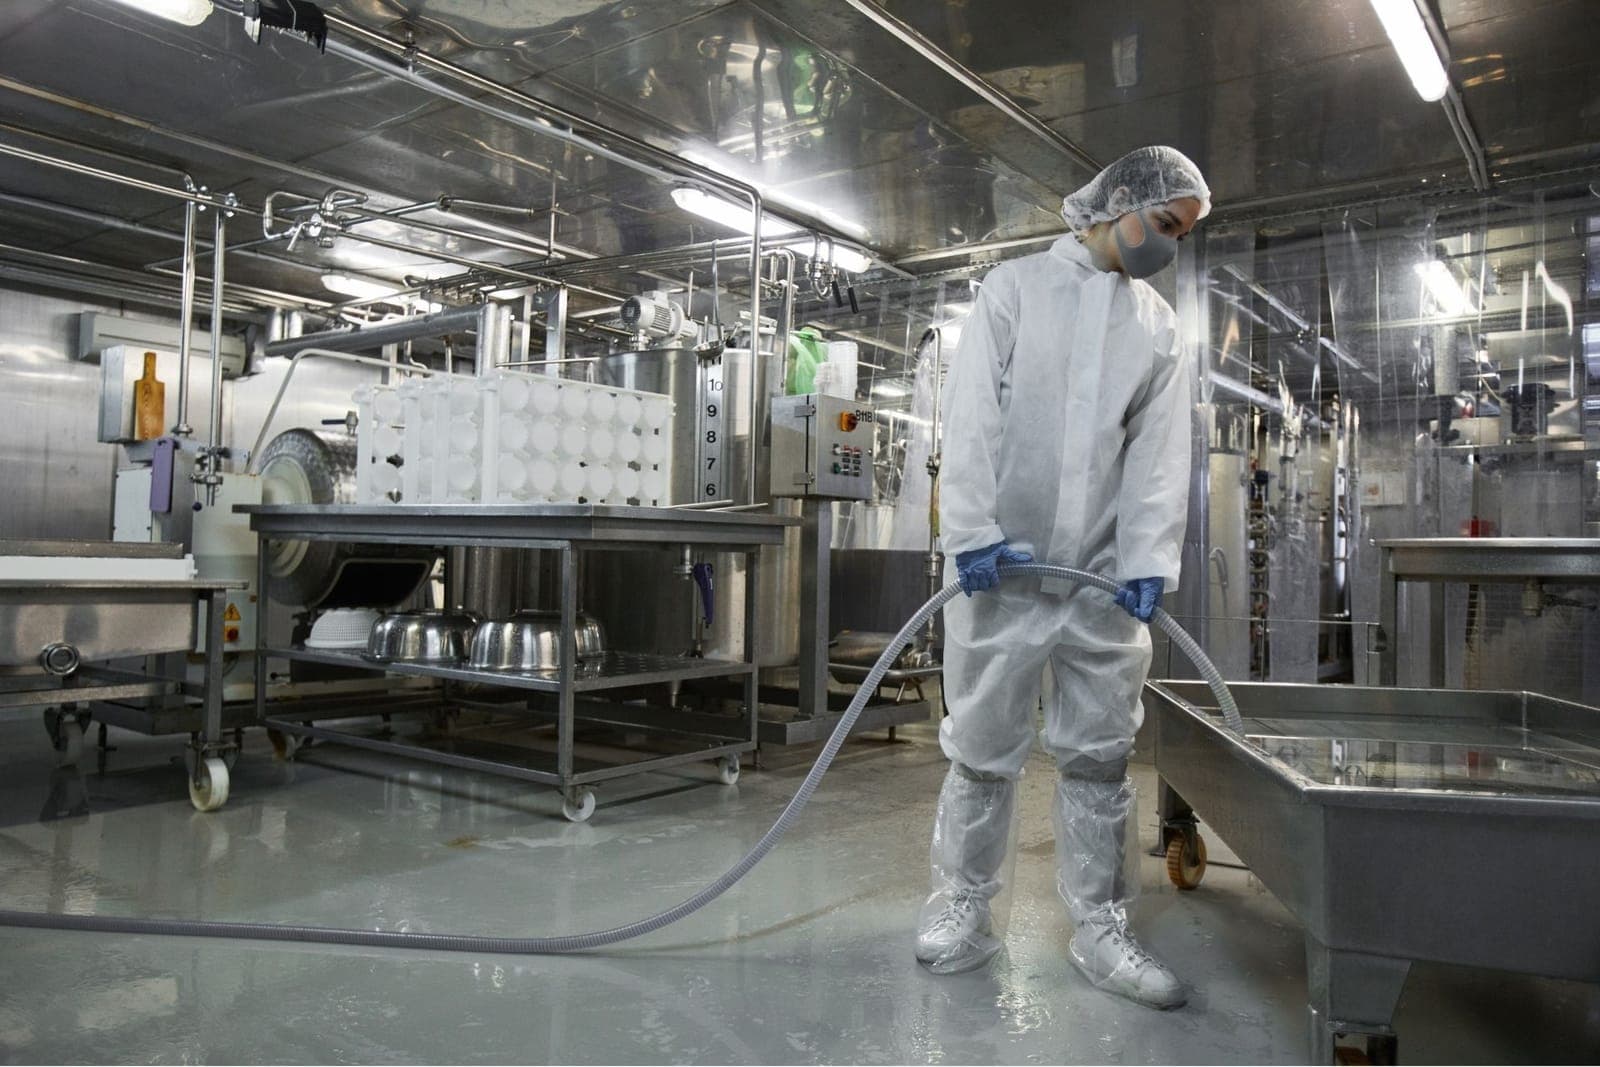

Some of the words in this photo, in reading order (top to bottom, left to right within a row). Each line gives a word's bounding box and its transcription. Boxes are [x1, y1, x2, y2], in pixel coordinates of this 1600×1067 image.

[709, 379, 723, 391] 10
[707, 404, 717, 417] 9
[706, 430, 716, 443] 8
[707, 457, 716, 470] 7
[706, 483, 716, 496] 6
